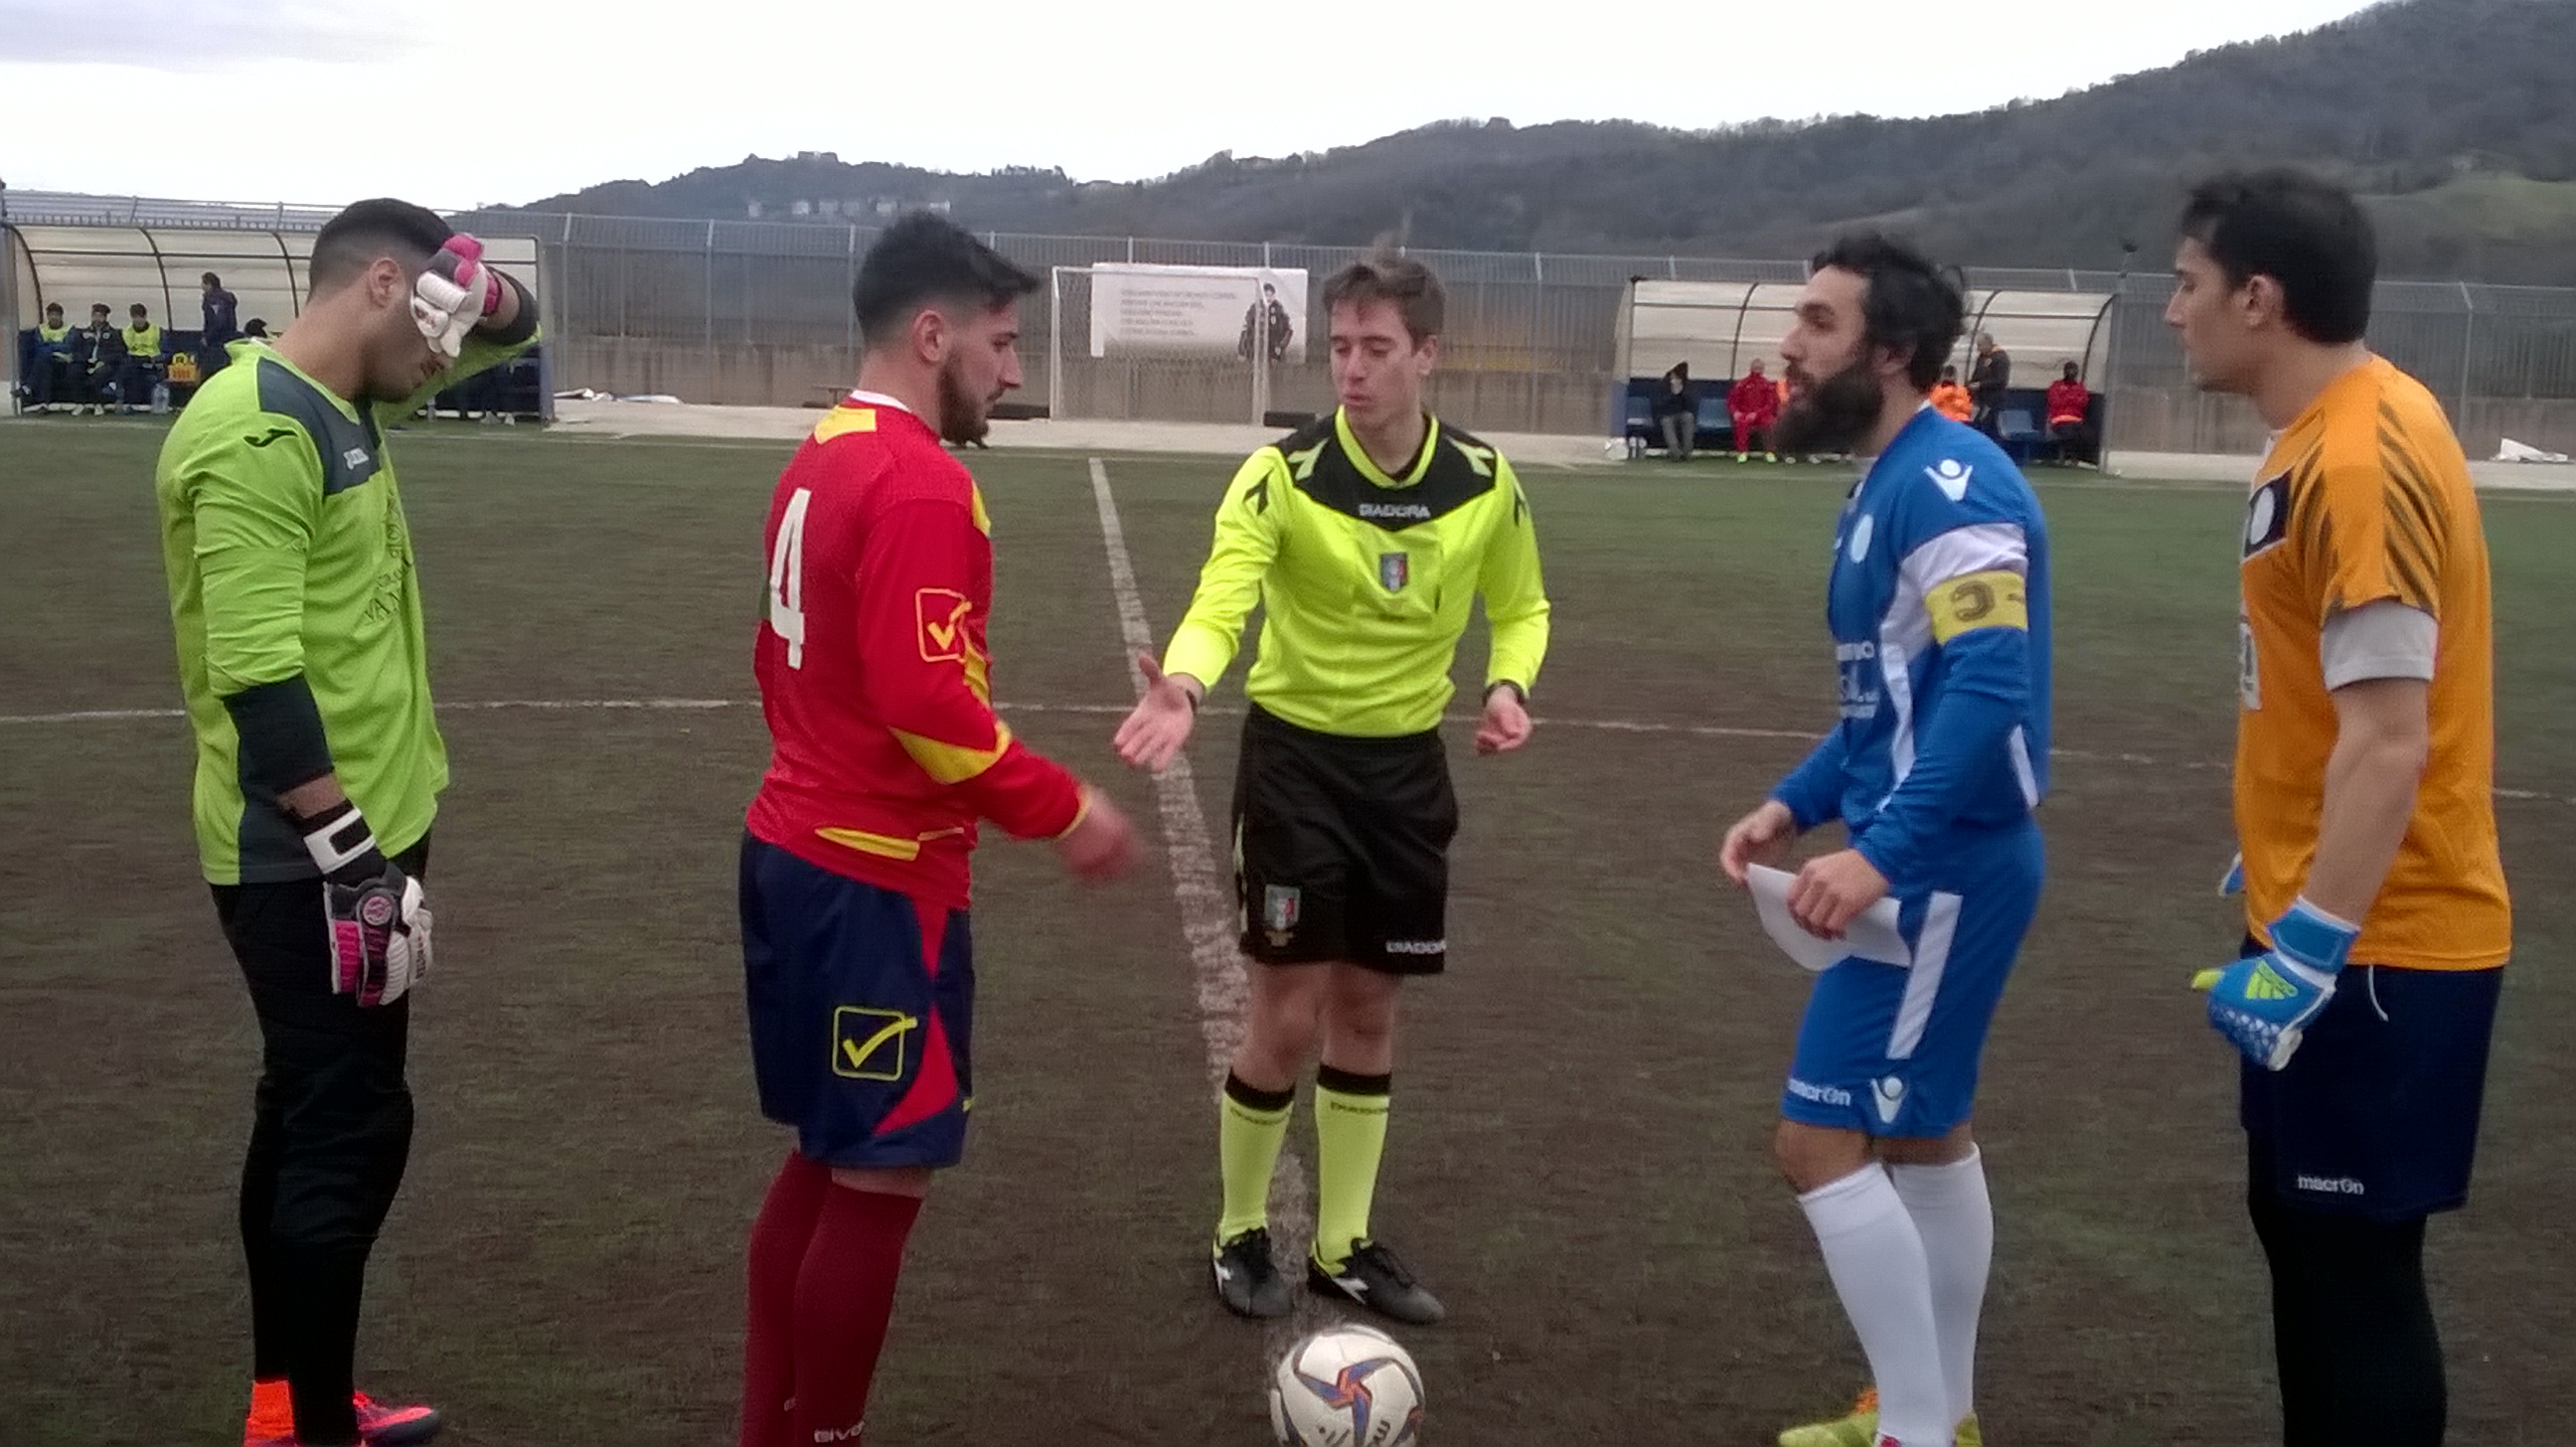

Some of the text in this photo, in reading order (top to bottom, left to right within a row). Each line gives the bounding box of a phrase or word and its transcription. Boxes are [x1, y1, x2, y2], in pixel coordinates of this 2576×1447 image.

[1359, 503, 1430, 519] DIADORA
[770, 487, 811, 670] 4
[2298, 1175, 2364, 1195] macron
